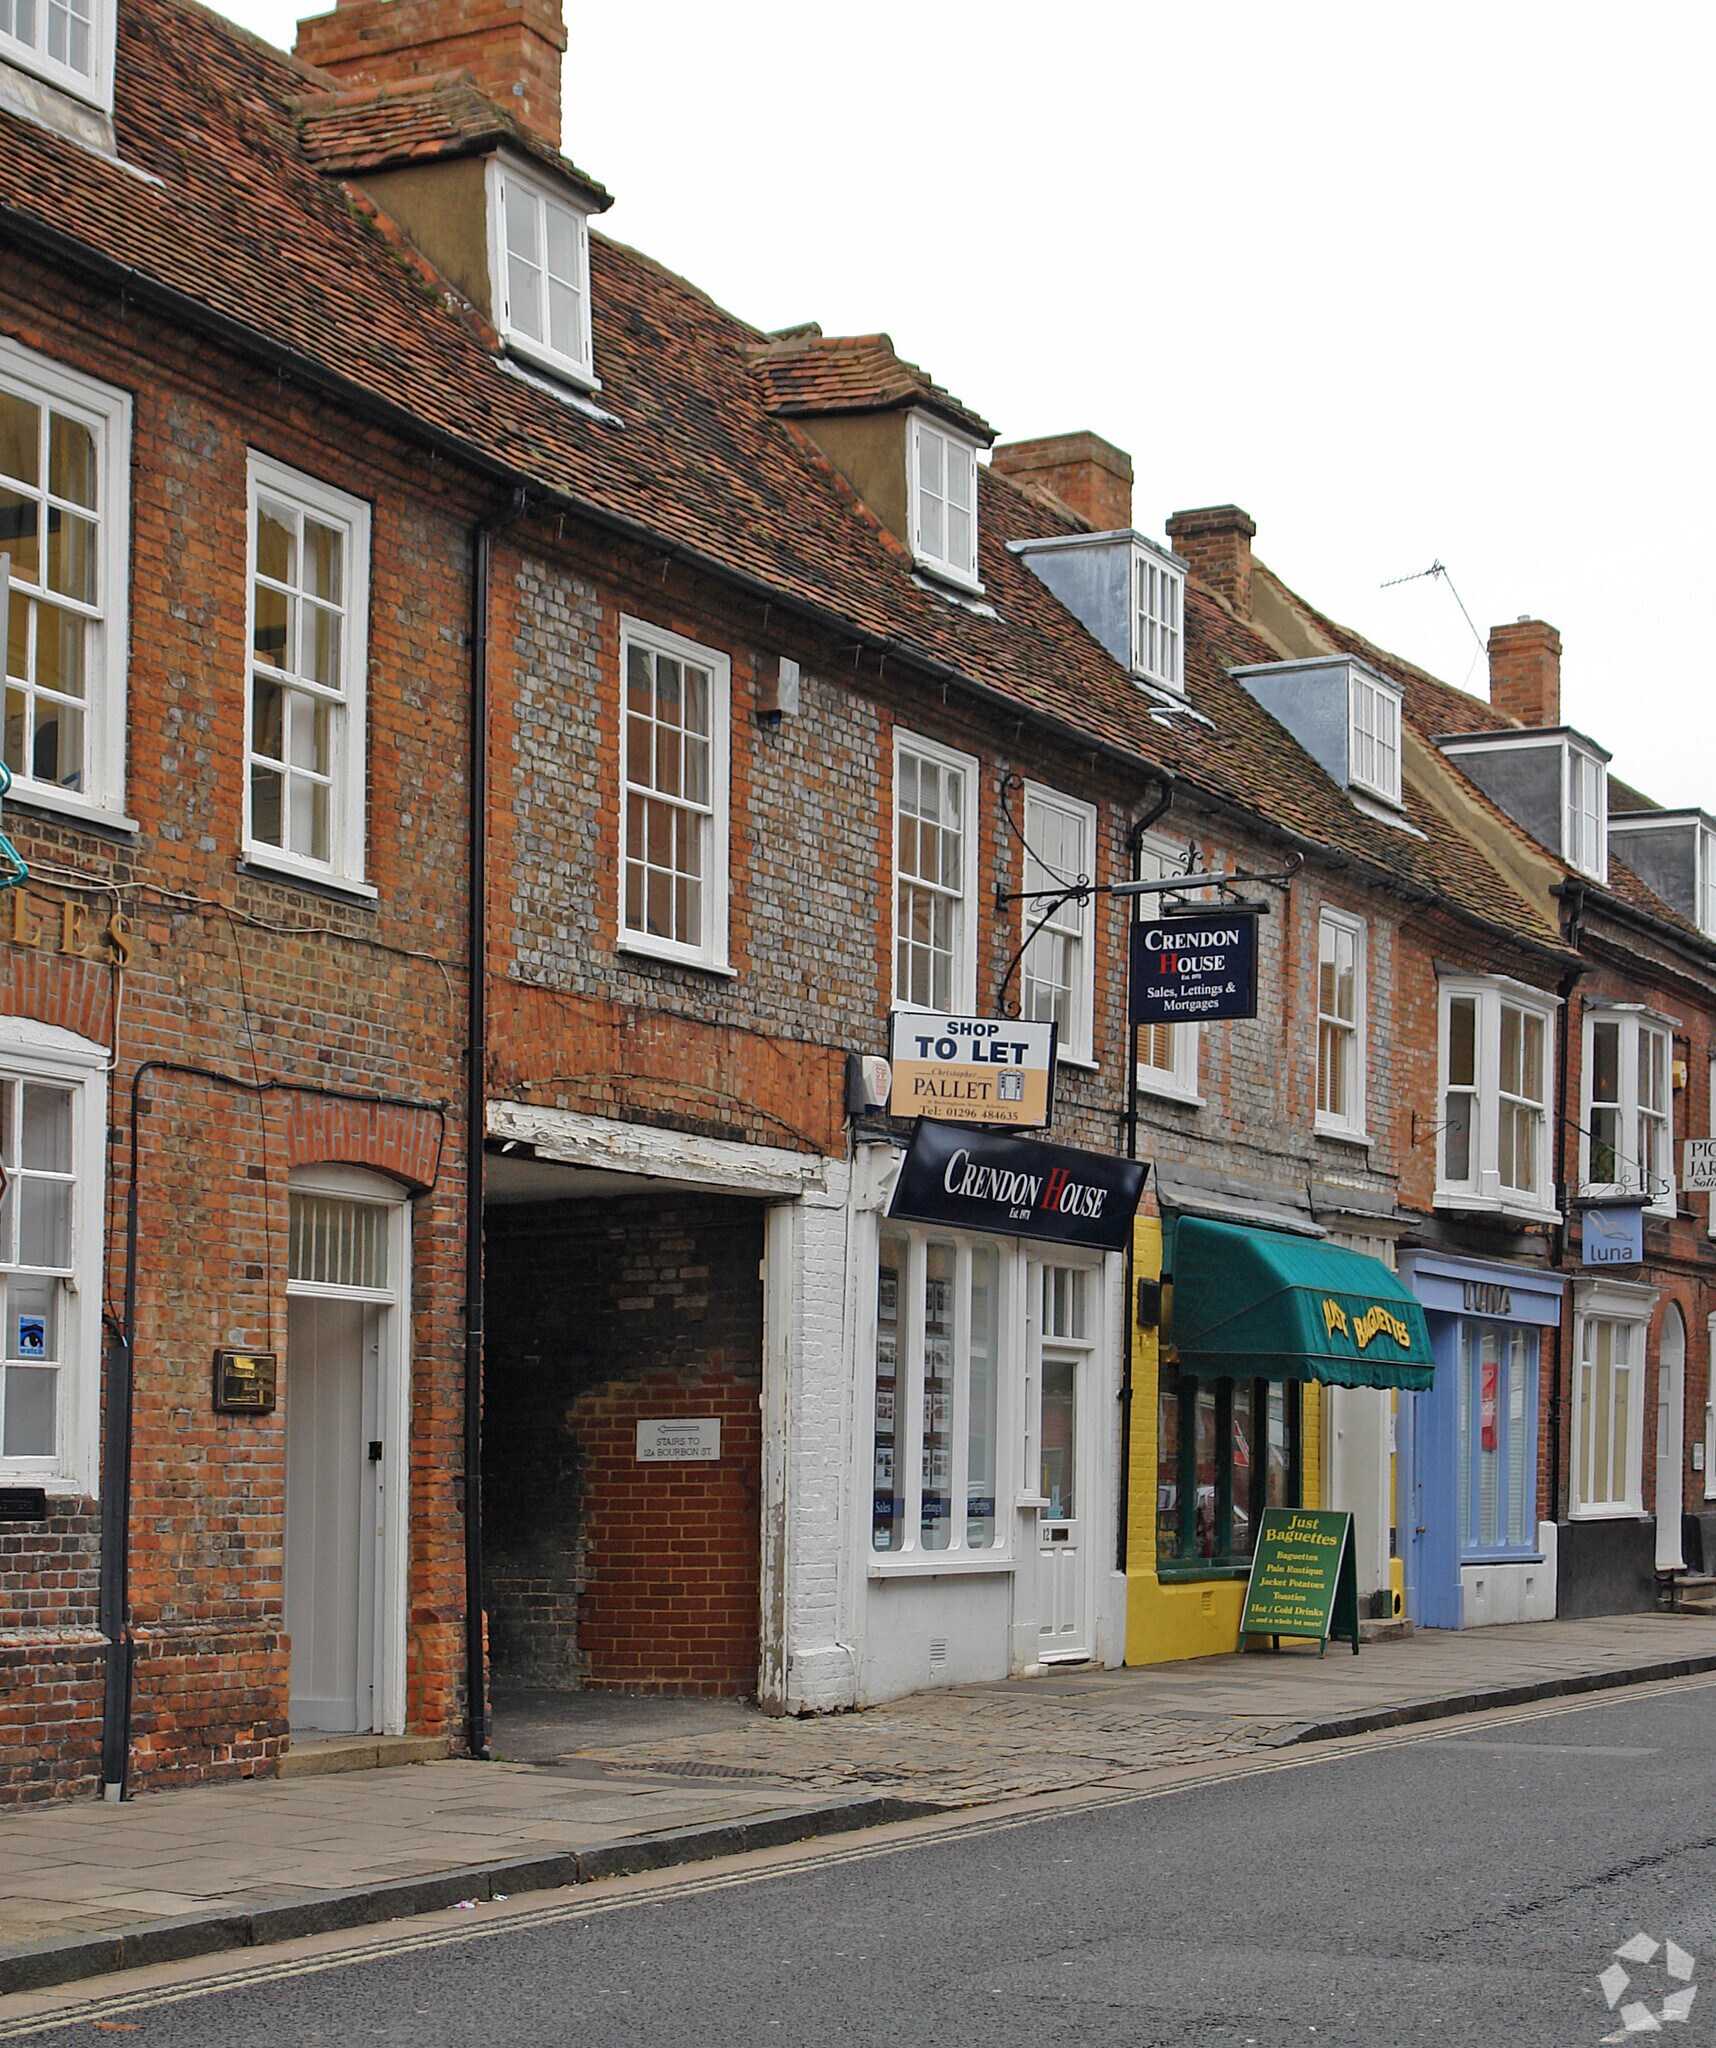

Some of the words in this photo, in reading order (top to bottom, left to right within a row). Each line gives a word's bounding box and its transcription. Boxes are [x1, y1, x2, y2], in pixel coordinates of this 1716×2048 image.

[1145, 930, 1239, 950] CRENDON
[1159, 953, 1225, 974] HOUSE
[1147, 986, 1178, 998] Sales,
[1180, 984, 1222, 996] Lettings
[1225, 982, 1236, 992] &
[1164, 1000, 1219, 1012] Mortgages
[946, 1021, 999, 1037] SHOP
[915, 1036, 957, 1060] TO
[972, 1041, 1029, 1064] LET
[932, 1068, 977, 1078] Christopher
[913, 1077, 992, 1100] PALLET
[920, 1105, 942, 1116] Tel:
[946, 1108, 977, 1118] 01296
[982, 1110, 1018, 1120] 484635
[944, 1148, 1042, 1206] CRENDON
[1040, 1168, 1108, 1219] HOUSE
[1692, 1178, 1716, 1188] Soli
[1590, 1244, 1632, 1262] luna
[1464, 1281, 1512, 1314] LUNA
[1322, 1298, 1348, 1340] JUST
[1352, 1305, 1410, 1348] BAGUETTES
[656, 1438, 685, 1446] STAIRS
[688, 1437, 700, 1445] TO
[657, 1448, 698, 1456] BOURBON
[876, 1502, 891, 1513] Sales
[1288, 1515, 1319, 1530] Just
[1042, 1528, 1050, 1541] 12
[1265, 1528, 1338, 1546] Baguettes
[1276, 1551, 1318, 1562] Baguettes
[1266, 1564, 1284, 1573] Pain
[1287, 1565, 1324, 1576] Rustique
[1259, 1577, 1287, 1586] Jacket
[1289, 1579, 1325, 1589] Potatoes
[1273, 1592, 1306, 1602] Toasties
[1251, 1604, 1266, 1612] Hot
[1274, 1605, 1293, 1614] Cold
[1294, 1607, 1324, 1616] Drinks
